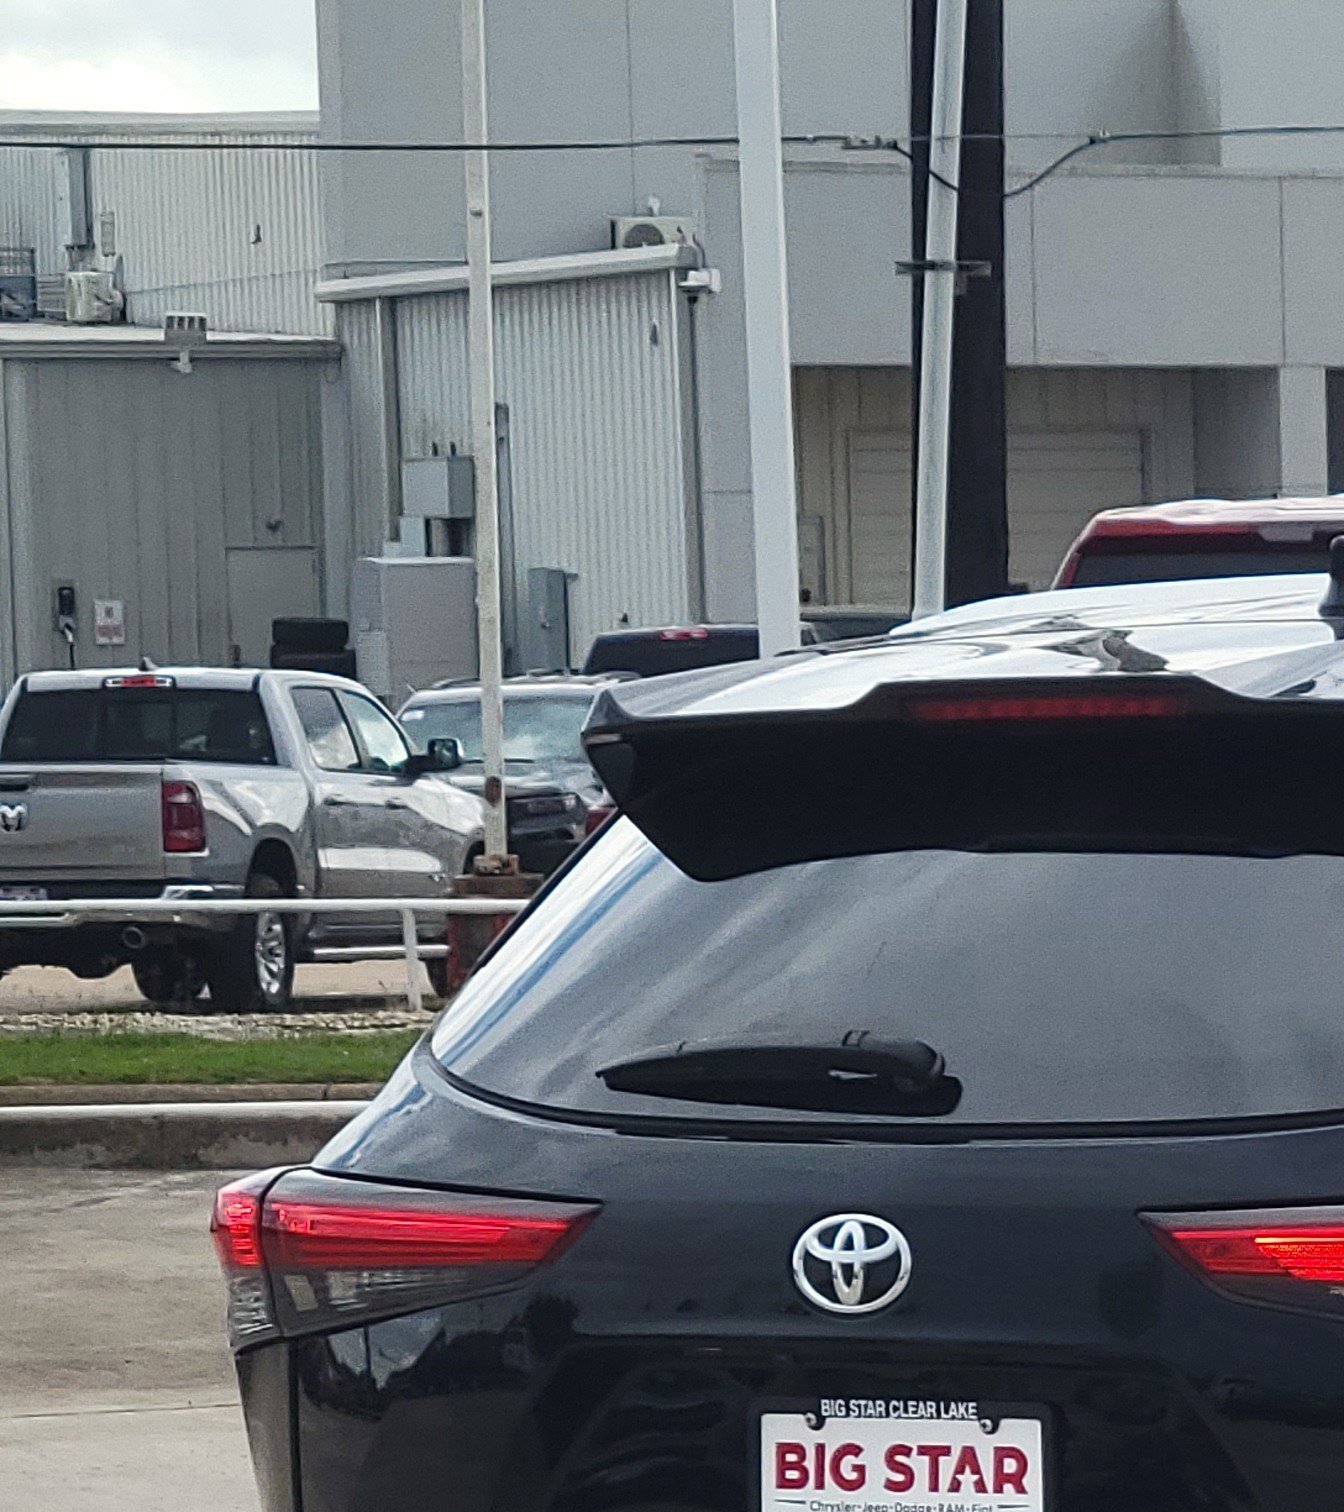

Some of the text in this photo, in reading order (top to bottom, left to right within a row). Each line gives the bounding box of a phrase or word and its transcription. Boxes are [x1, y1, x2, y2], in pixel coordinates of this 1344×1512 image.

[820, 1399, 978, 1419] BIG STAR CLEAR LAKE
[775, 1442, 1028, 1494] BIG STAR
